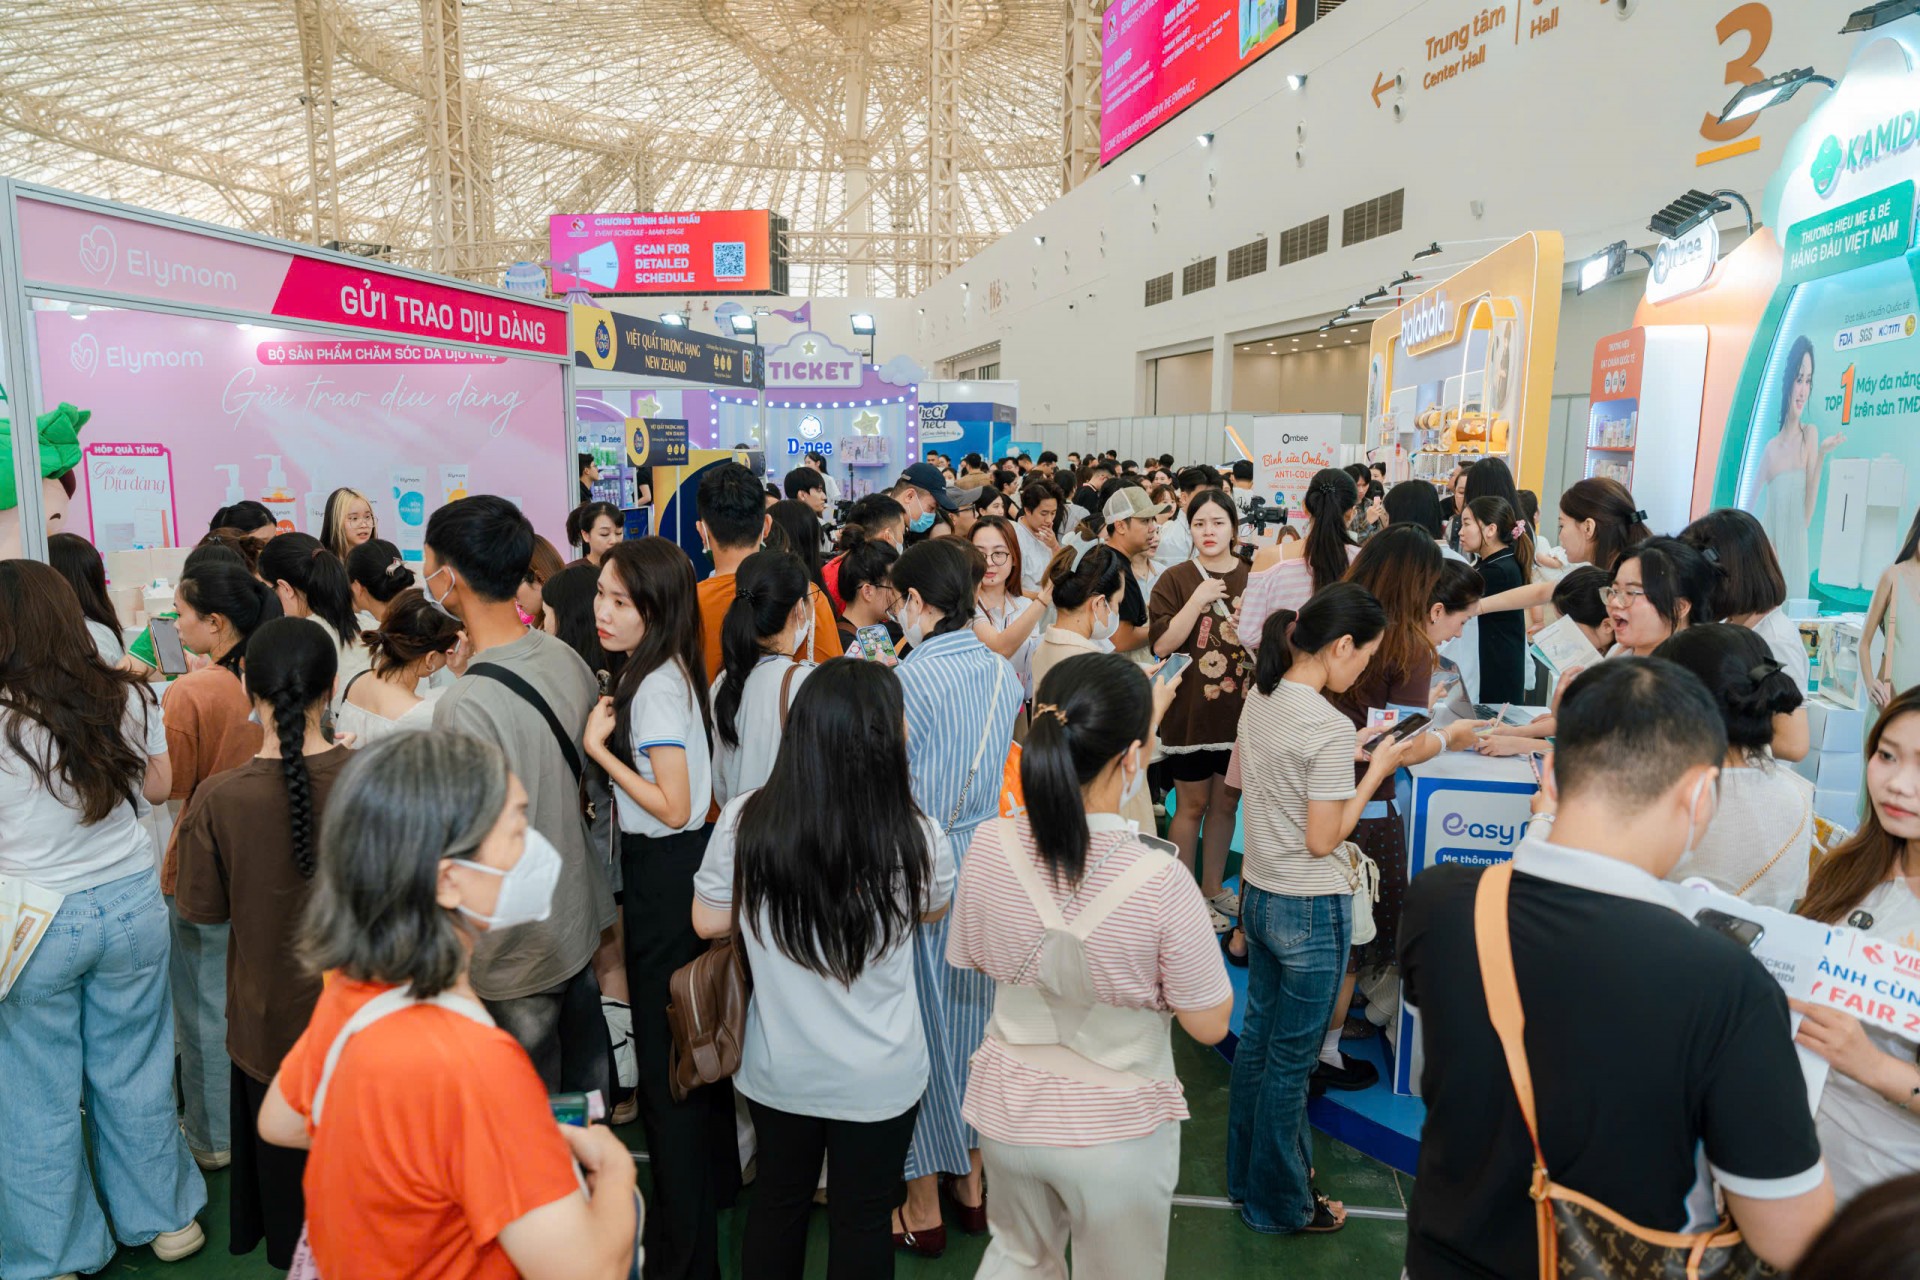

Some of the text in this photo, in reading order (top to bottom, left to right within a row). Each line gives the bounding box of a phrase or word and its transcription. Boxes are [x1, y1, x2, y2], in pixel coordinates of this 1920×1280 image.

[1426, 4, 1506, 61] Trung tâm
[1530, 6, 1559, 39] Hall
[1423, 44, 1486, 91] Center Hall
[1699, 2, 1773, 141] 3
[594, 216, 631, 226] CHƯƠNG
[633, 214, 656, 226] TRÌNH
[658, 214, 675, 225] SÂN
[1801, 198, 1891, 245] THƯƠNG HIỆU MẸ & BÉ
[634, 243, 690, 255] SCAN FOR
[1790, 219, 1899, 270] HÀNG ĐẦU VIỆT NAM
[127, 248, 238, 291] Elymom
[635, 258, 689, 269] DETAILED
[635, 272, 695, 284] SCHEDULE
[340, 278, 546, 344] GỬI TRAO DỊU DÀNG
[1401, 291, 1446, 348] balabala
[625, 328, 641, 350] VIỆT
[641, 329, 660, 351] QUẤT
[659, 337, 684, 356] THƯỢNG
[684, 343, 701, 359] HẠNG
[1838, 333, 1853, 347] FDA
[1859, 327, 1873, 342] SGS
[106, 345, 204, 374] Elymom
[268, 345, 286, 363] BỘ
[288, 343, 313, 360] SẢN
[316, 342, 352, 361] PHẨM
[355, 345, 392, 360] CHĂM
[395, 345, 421, 359] SÓC
[424, 348, 442, 359] DA
[645, 355, 687, 374] NEW ZEALAND
[768, 361, 854, 380] TICKET
[1856, 371, 1920, 395] Máy đa năng
[305, 374, 372, 415] trao
[381, 374, 436, 418] dịu
[447, 373, 526, 437] dàng
[1825, 362, 1855, 425] TOP 1
[1854, 395, 1920, 418] trên sàn TMĐ
[601, 434, 621, 443] D-nee
[787, 438, 833, 455] D-nee
[1282, 433, 1309, 445] Ombee
[1262, 450, 1282, 467] Bình
[1301, 451, 1330, 467] Ombee
[1442, 812, 1514, 845] easy
[1893, 950, 1920, 971] VIE
[1818, 956, 1867, 987] ÀNH
[1874, 979, 1920, 1007] CÙN
[1828, 986, 1895, 1024] FAIR
[1903, 1013, 1920, 1033] 2
